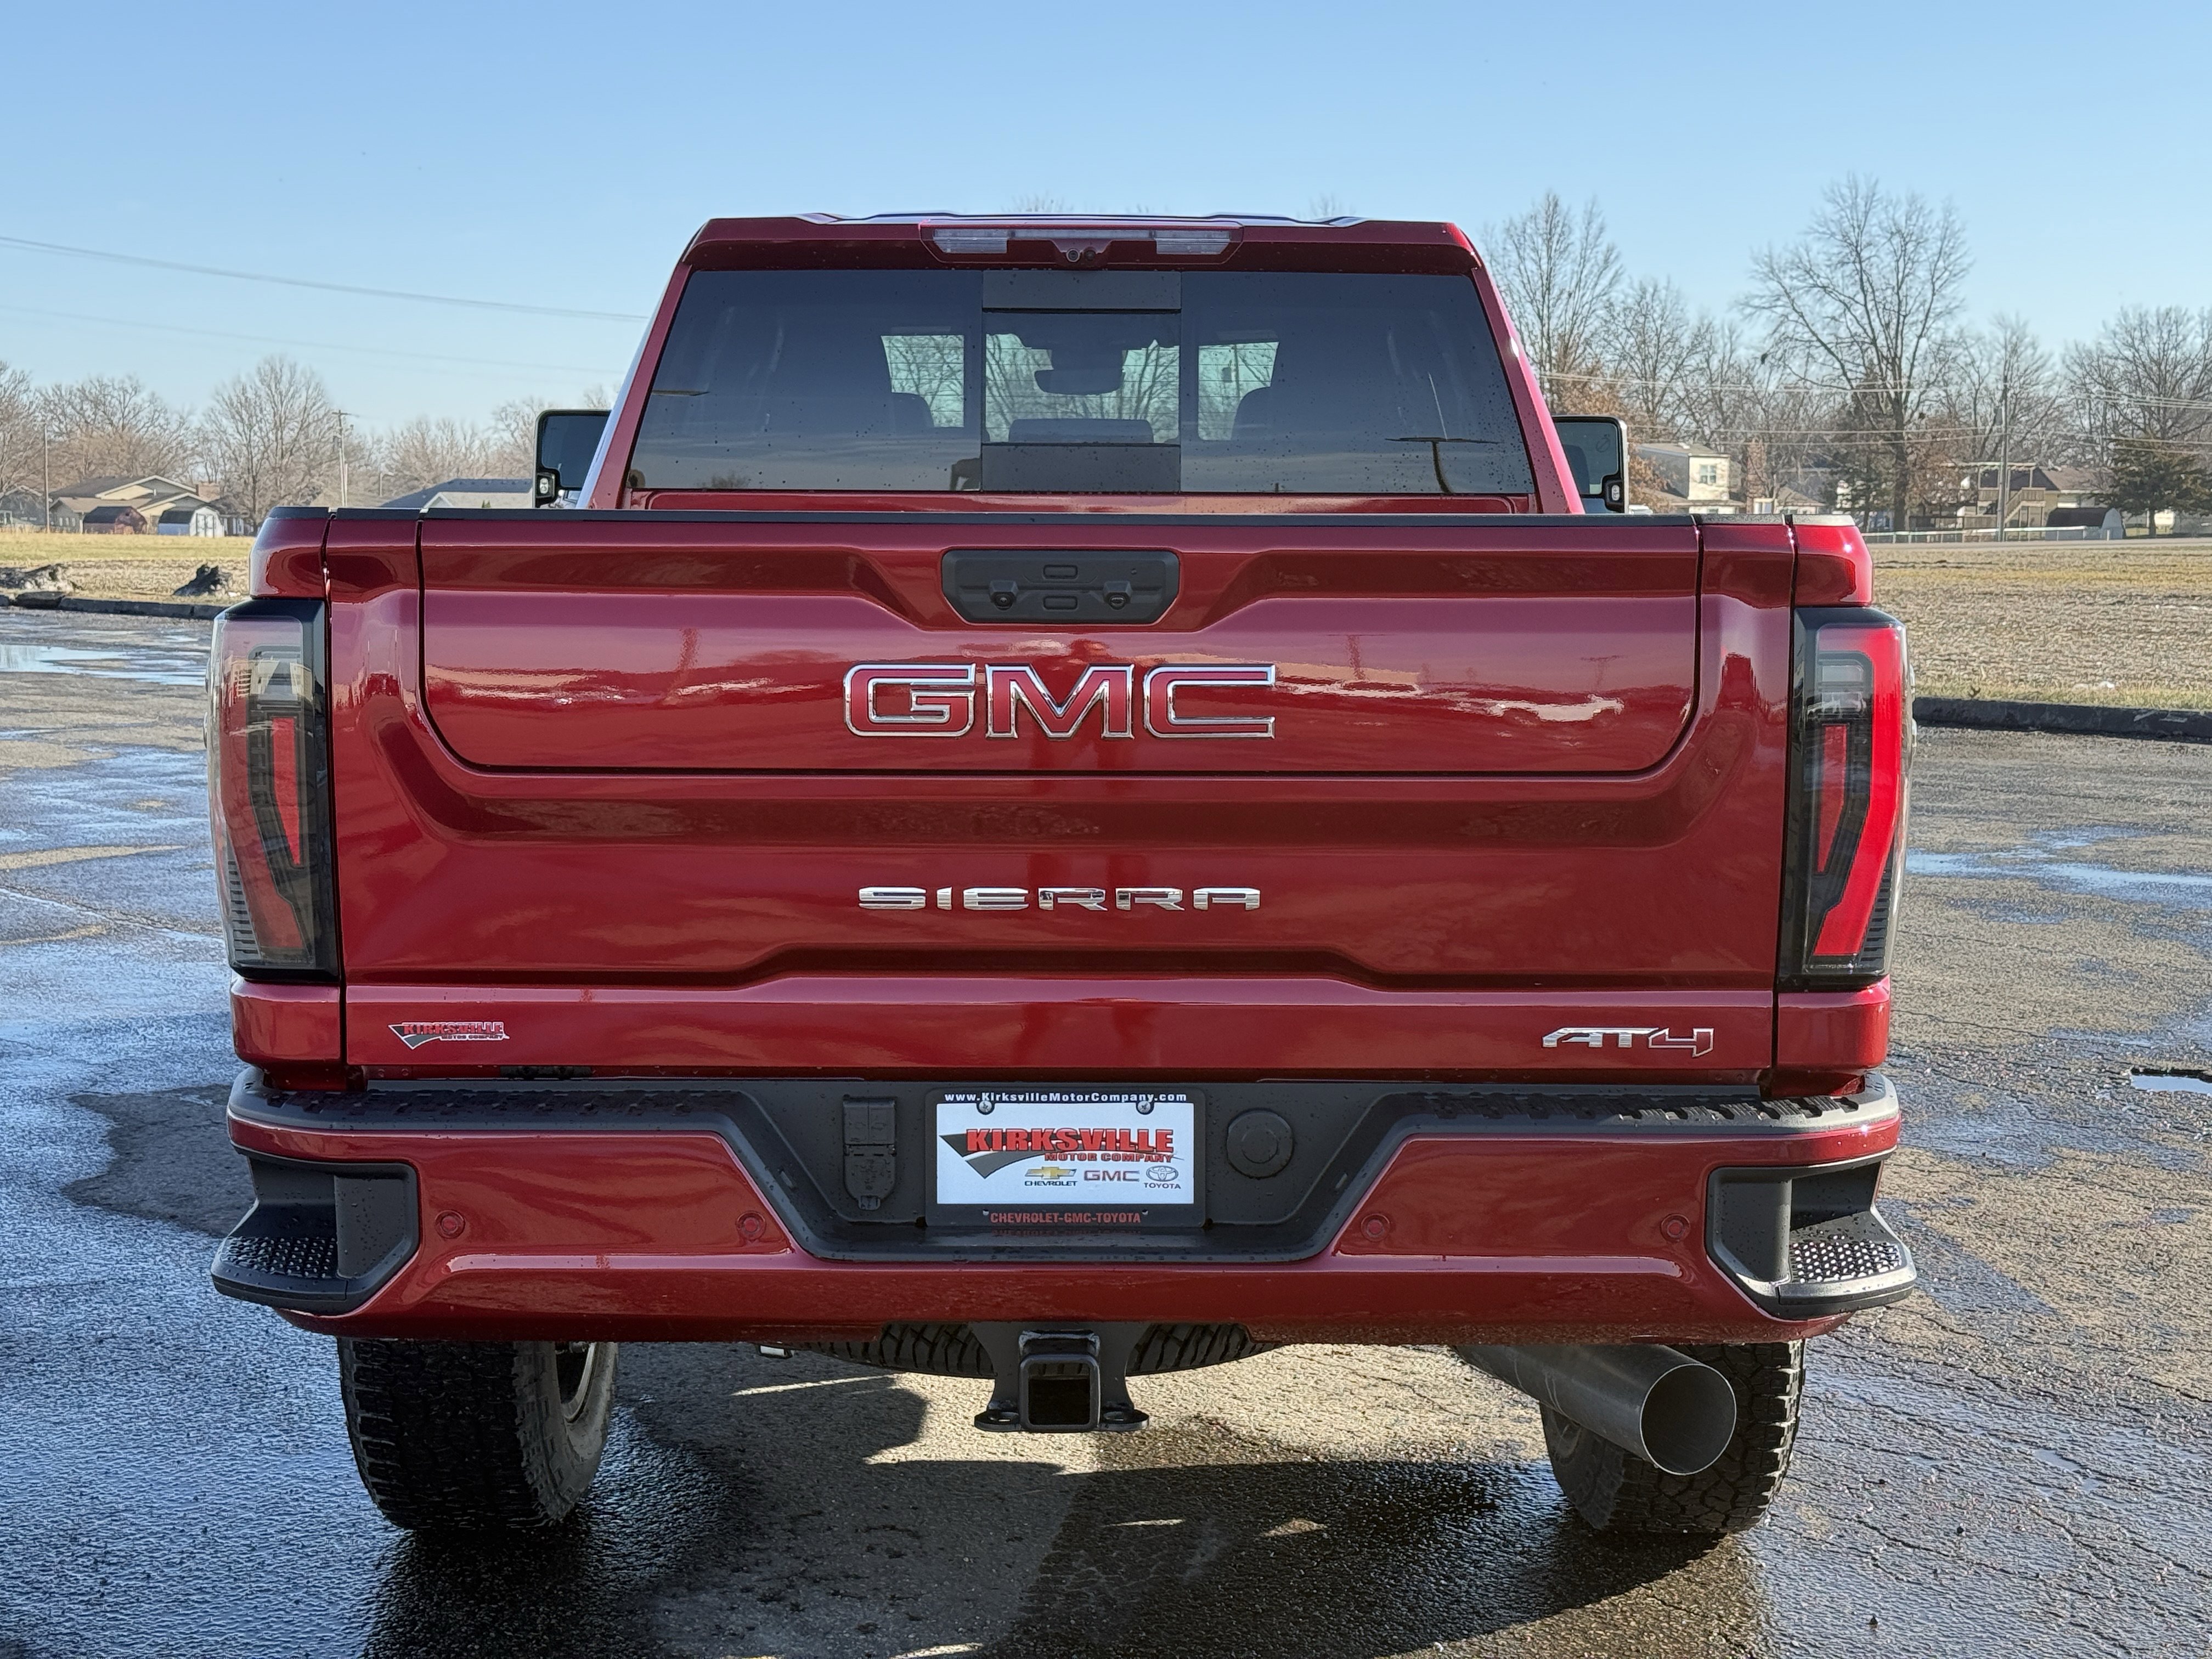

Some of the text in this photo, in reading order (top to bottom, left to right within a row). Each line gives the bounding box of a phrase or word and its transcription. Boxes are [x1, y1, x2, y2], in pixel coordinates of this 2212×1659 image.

[844, 663, 1276, 740] GMC
[858, 886, 1261, 911] SIERRA
[1542, 1028, 1714, 1058] AT4
[944, 1092, 1187, 1102] www.KirksvilleMotorCompany.com
[966, 1128, 1173, 1152] KIRKSVILLE
[1045, 1153, 1173, 1163] MOTOR COMPANY
[1084, 1170, 1140, 1182] GMC
[990, 1213, 1141, 1223] CHEVROLET-GMC-TOYOTA
